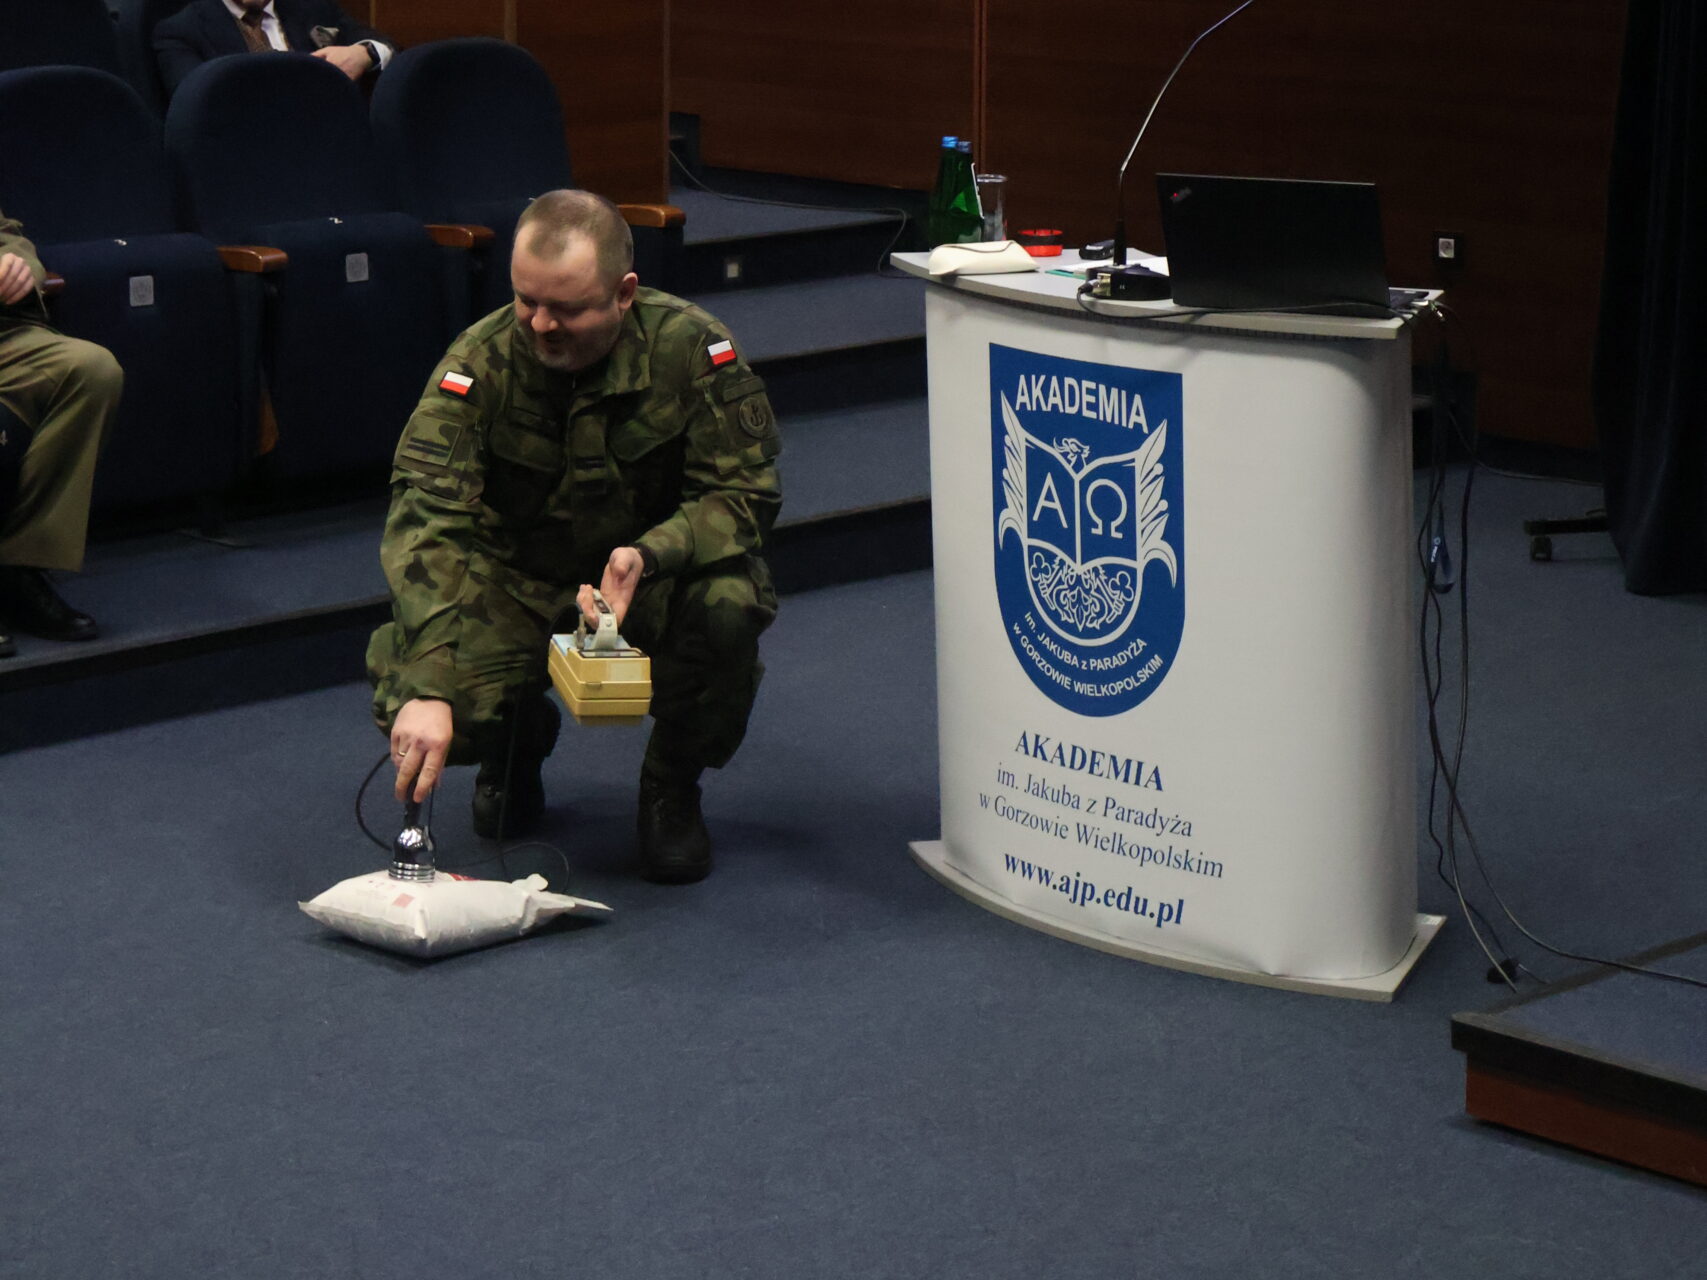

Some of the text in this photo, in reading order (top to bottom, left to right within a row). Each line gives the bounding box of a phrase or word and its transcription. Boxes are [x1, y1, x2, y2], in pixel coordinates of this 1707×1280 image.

[1015, 374, 1149, 434] AKADEMIA
[1086, 478, 1128, 539] Ω
[1020, 635, 1071, 690] GORZOWIE
[1074, 653, 1164, 697] WIELKOPOLSKIM
[1037, 632, 1079, 668] JAKUBA
[1081, 660, 1087, 670] z
[1089, 638, 1147, 671] PARADYŻA
[1014, 730, 1164, 792] AKADEMIA
[997, 762, 1192, 837] im. Jakuba z Paradyża
[979, 793, 1224, 878] w Gorzowie Wielkopolskim
[1004, 853, 1185, 928] www.ajp.edu.pl
